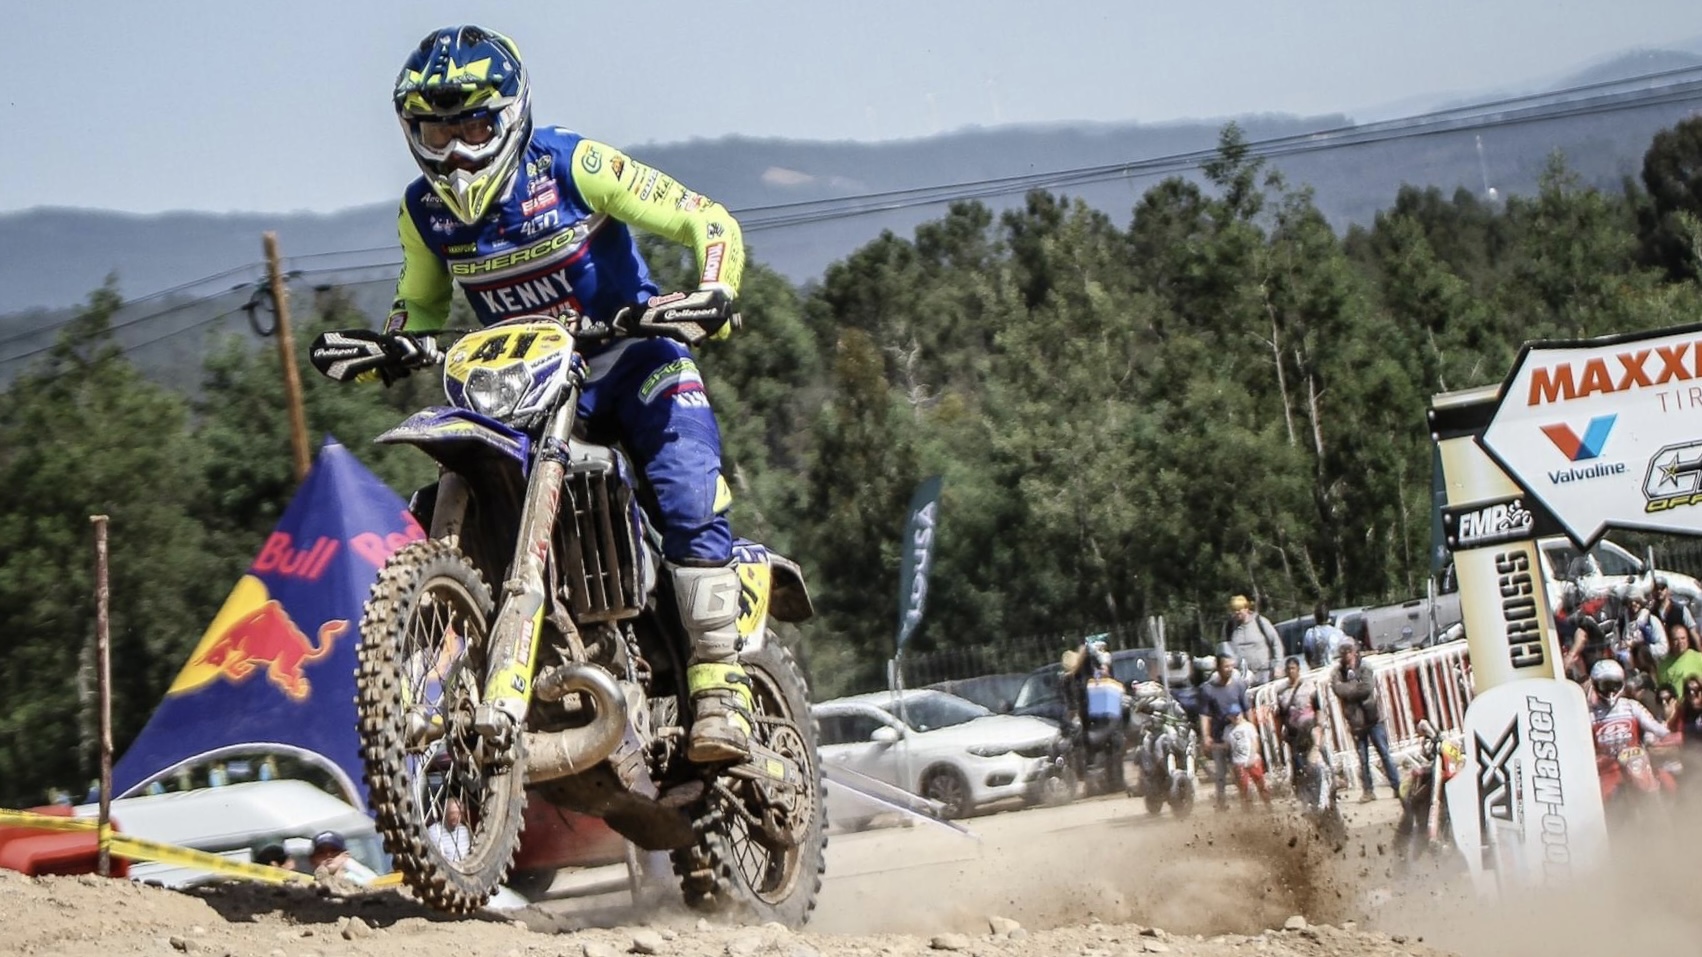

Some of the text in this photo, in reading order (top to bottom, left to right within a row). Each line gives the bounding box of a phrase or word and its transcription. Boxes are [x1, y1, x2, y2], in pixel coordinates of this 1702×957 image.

[452, 229, 575, 274] SHERCO
[702, 243, 724, 281] MOTUL
[480, 268, 573, 314] KENNY
[664, 307, 718, 320] Polisport
[314, 347, 359, 359] Polisport
[467, 332, 539, 363] 41
[1548, 463, 1626, 485] Valvoline
[253, 531, 340, 580] Bull
[1495, 550, 1544, 669] CROSS
